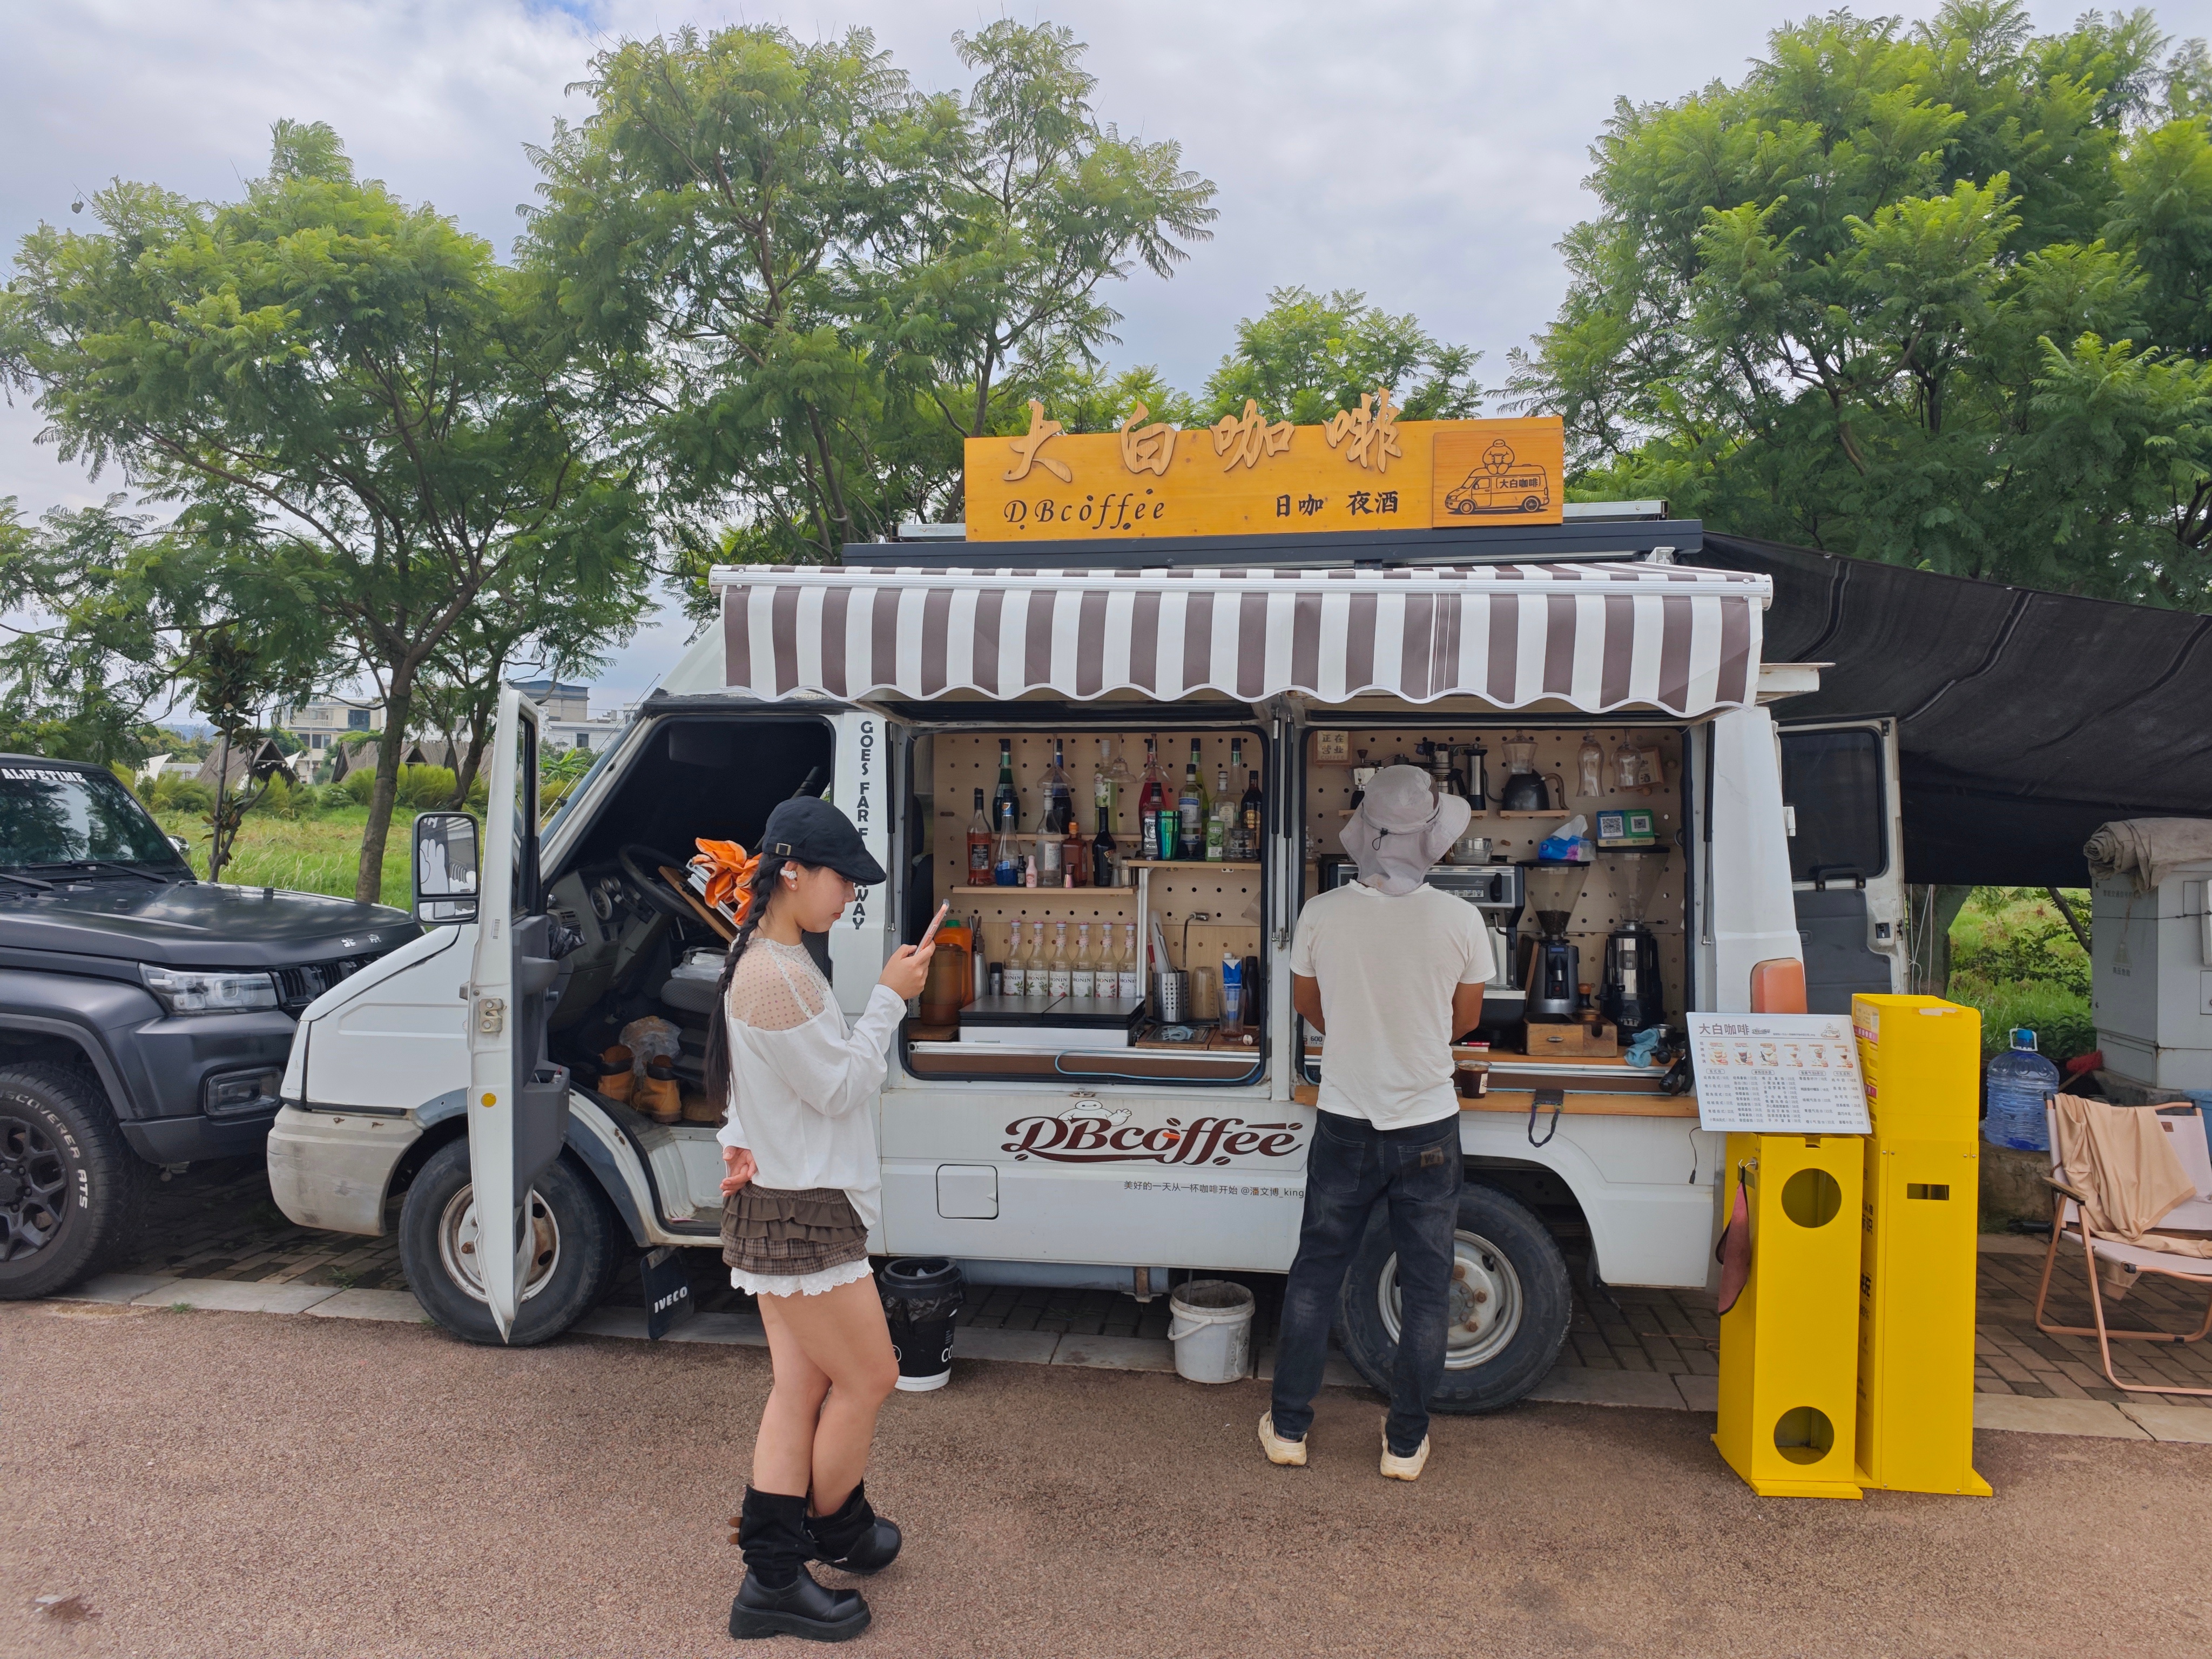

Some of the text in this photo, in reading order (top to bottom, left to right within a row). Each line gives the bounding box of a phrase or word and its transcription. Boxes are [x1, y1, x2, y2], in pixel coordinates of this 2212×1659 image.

[1002, 387, 1402, 483] 大白咖啡
[1499, 478, 1539, 490] 大白咖啡
[1275, 490, 1398, 518] 日咖 夜酒
[860, 720, 873, 777] GOES
[1321, 745, 1344, 754] 营业
[1322, 734, 1344, 743] 正在
[857, 782, 869, 822] FAR
[1698, 1023, 1750, 1036] 大白咖啡
[1001, 1116, 1305, 1166] DBcoffee
[1123, 1180, 1238, 1196] 美好的一天从一杯咖啡开始
[654, 1286, 688, 1314] IVECO
